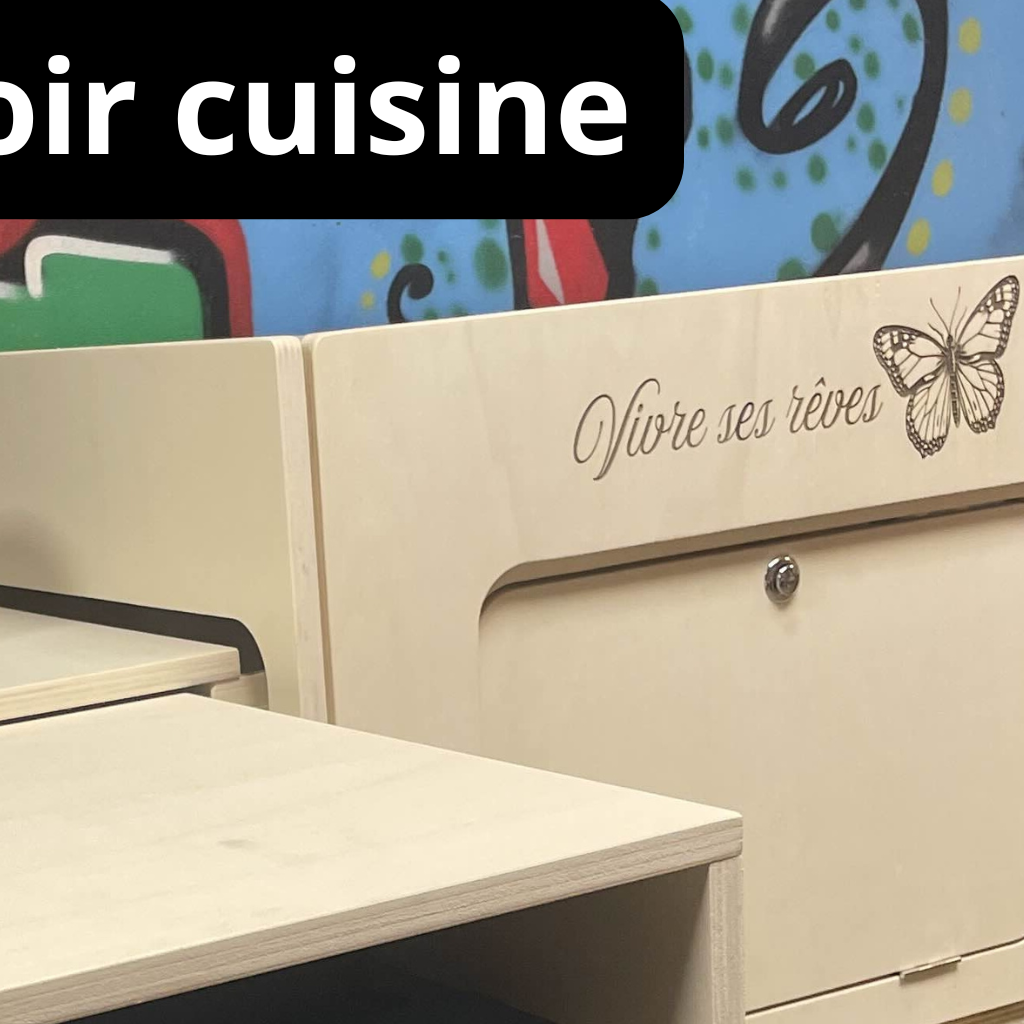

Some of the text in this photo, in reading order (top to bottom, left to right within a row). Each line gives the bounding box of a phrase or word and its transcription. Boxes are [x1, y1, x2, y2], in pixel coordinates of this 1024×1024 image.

[573, 377, 883, 481] Vivre ses rêves
